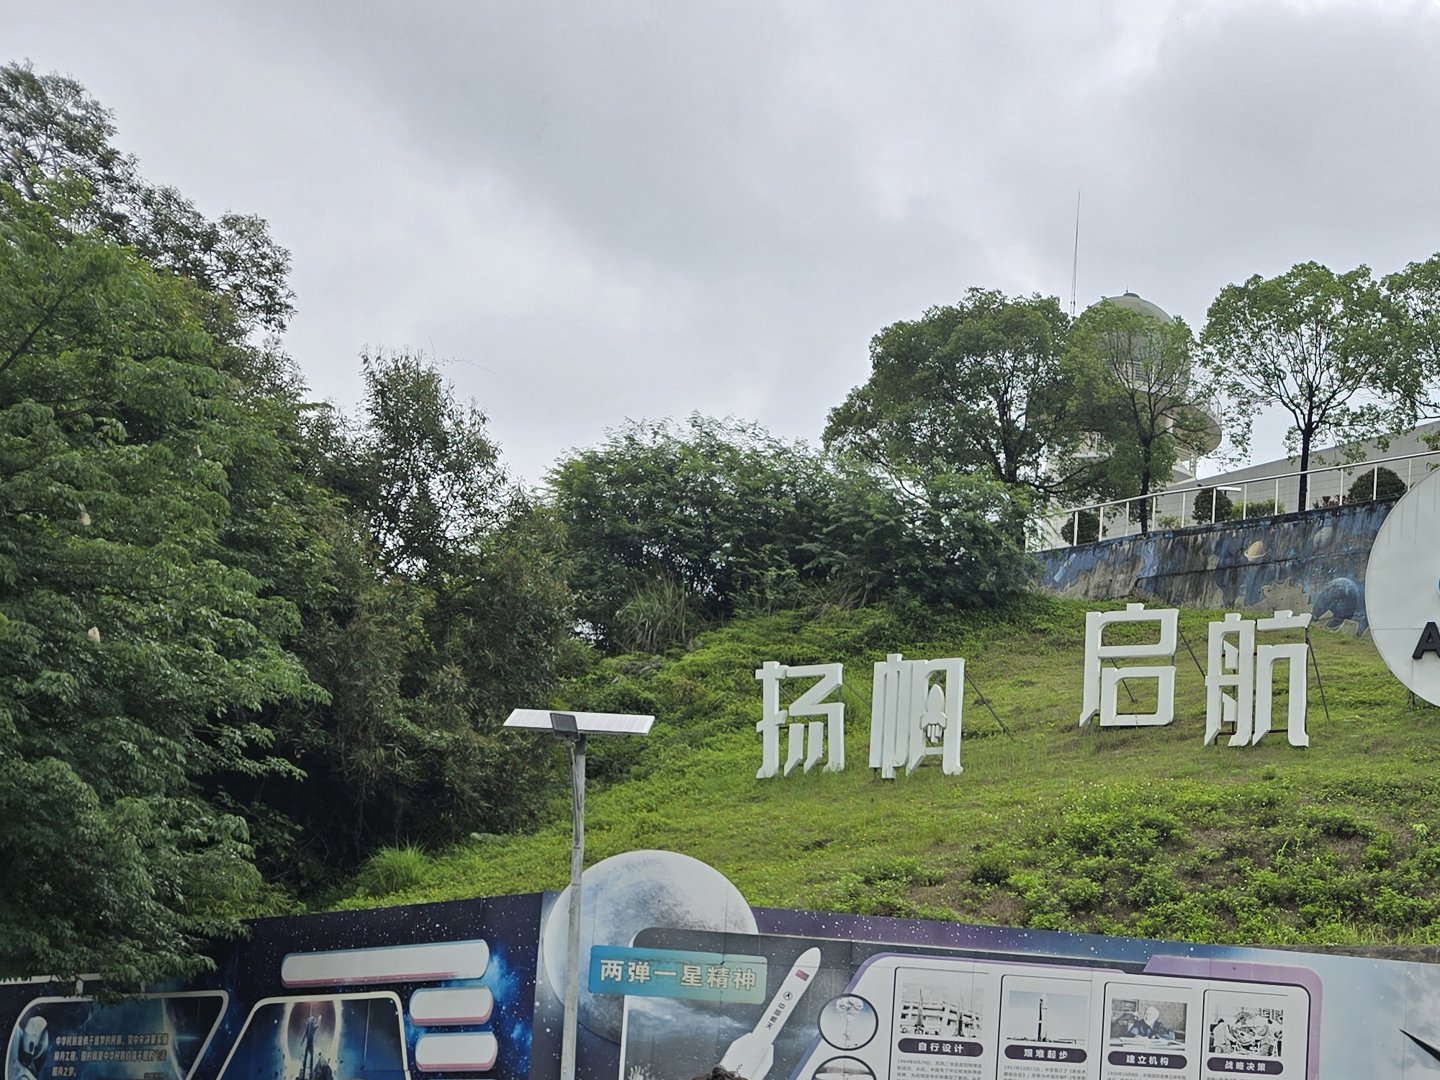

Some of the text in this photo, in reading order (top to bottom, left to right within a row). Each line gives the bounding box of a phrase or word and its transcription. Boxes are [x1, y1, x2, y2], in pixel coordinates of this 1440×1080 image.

[600, 959, 757, 991] 两弹一星精神
[918, 1041, 964, 1054] 自行设计
[1023, 1048, 1069, 1060] 艰难起步
[1126, 1054, 1169, 1066] 建立机构
[1224, 1060, 1267, 1072] 战略决策
